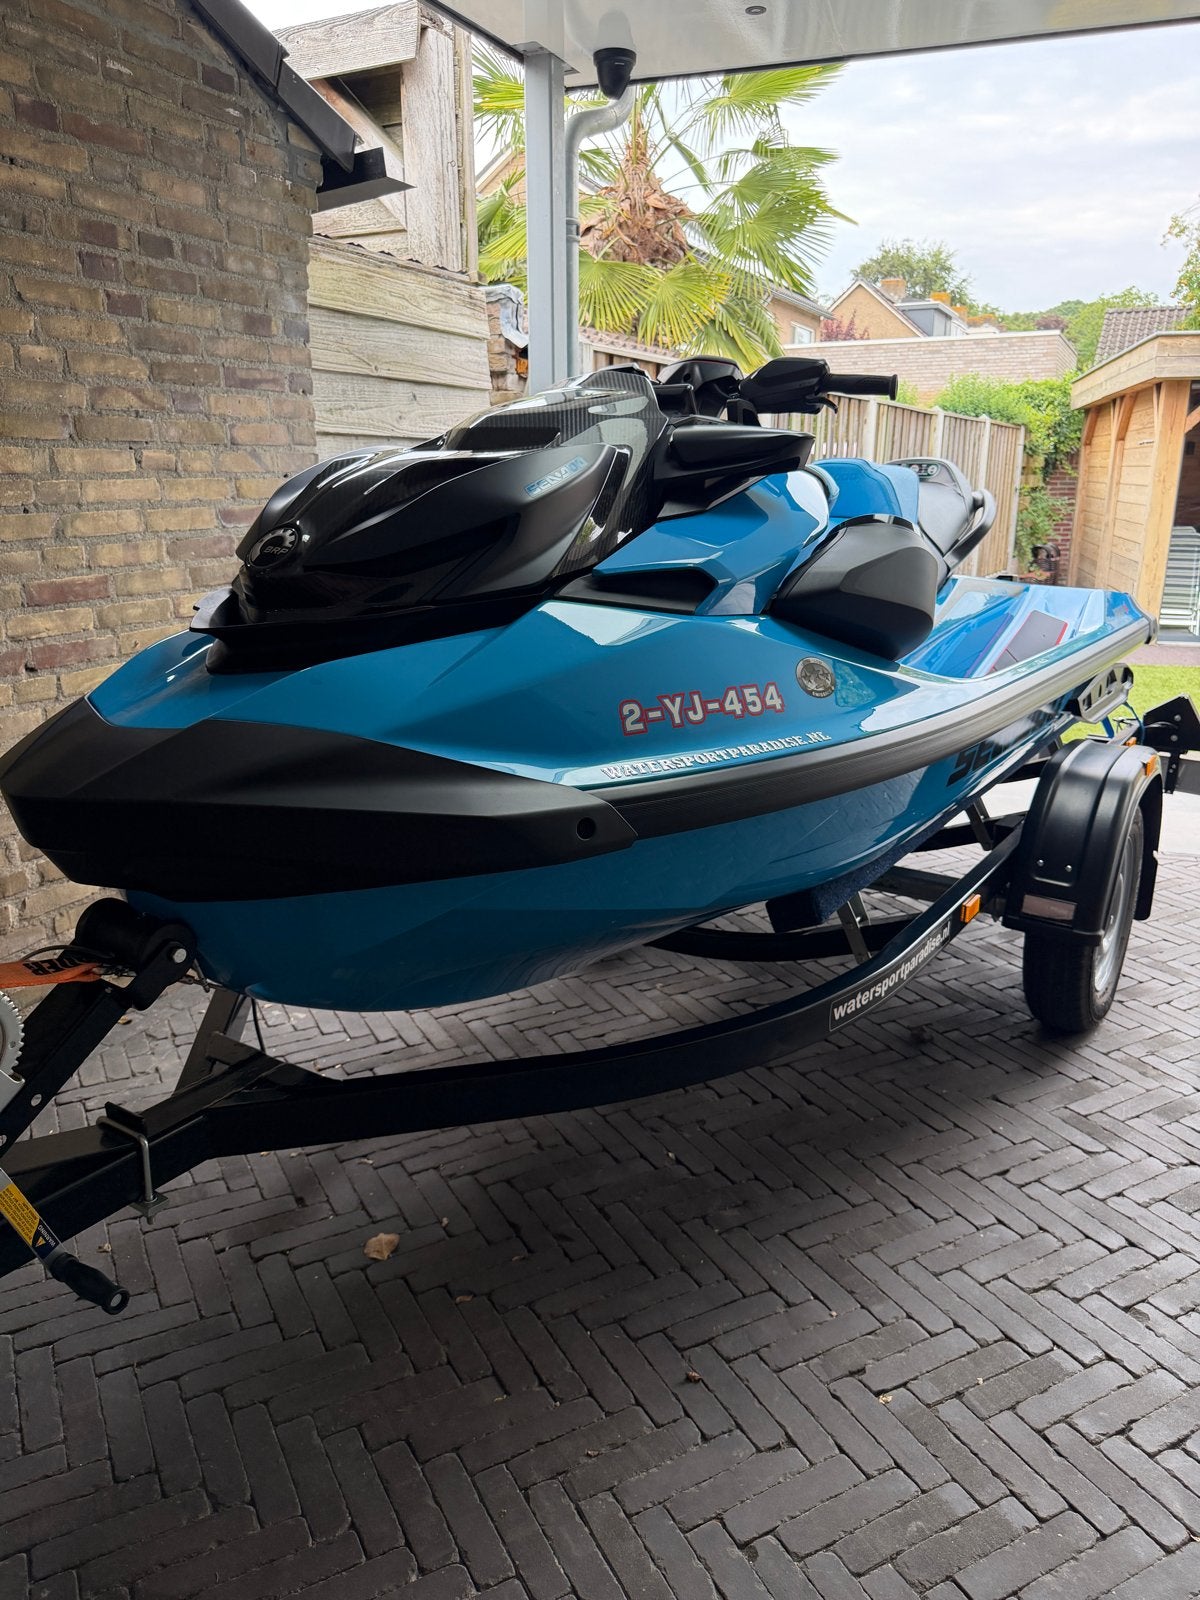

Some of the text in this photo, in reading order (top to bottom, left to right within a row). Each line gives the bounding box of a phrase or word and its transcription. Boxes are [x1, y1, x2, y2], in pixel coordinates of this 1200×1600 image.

[264, 546, 289, 555] BRP
[619, 682, 784, 736] 2-YJ-454
[600, 731, 831, 779] WATERSPORTPARADISE.NL
[833, 921, 950, 1021] watersportparadise.nl
